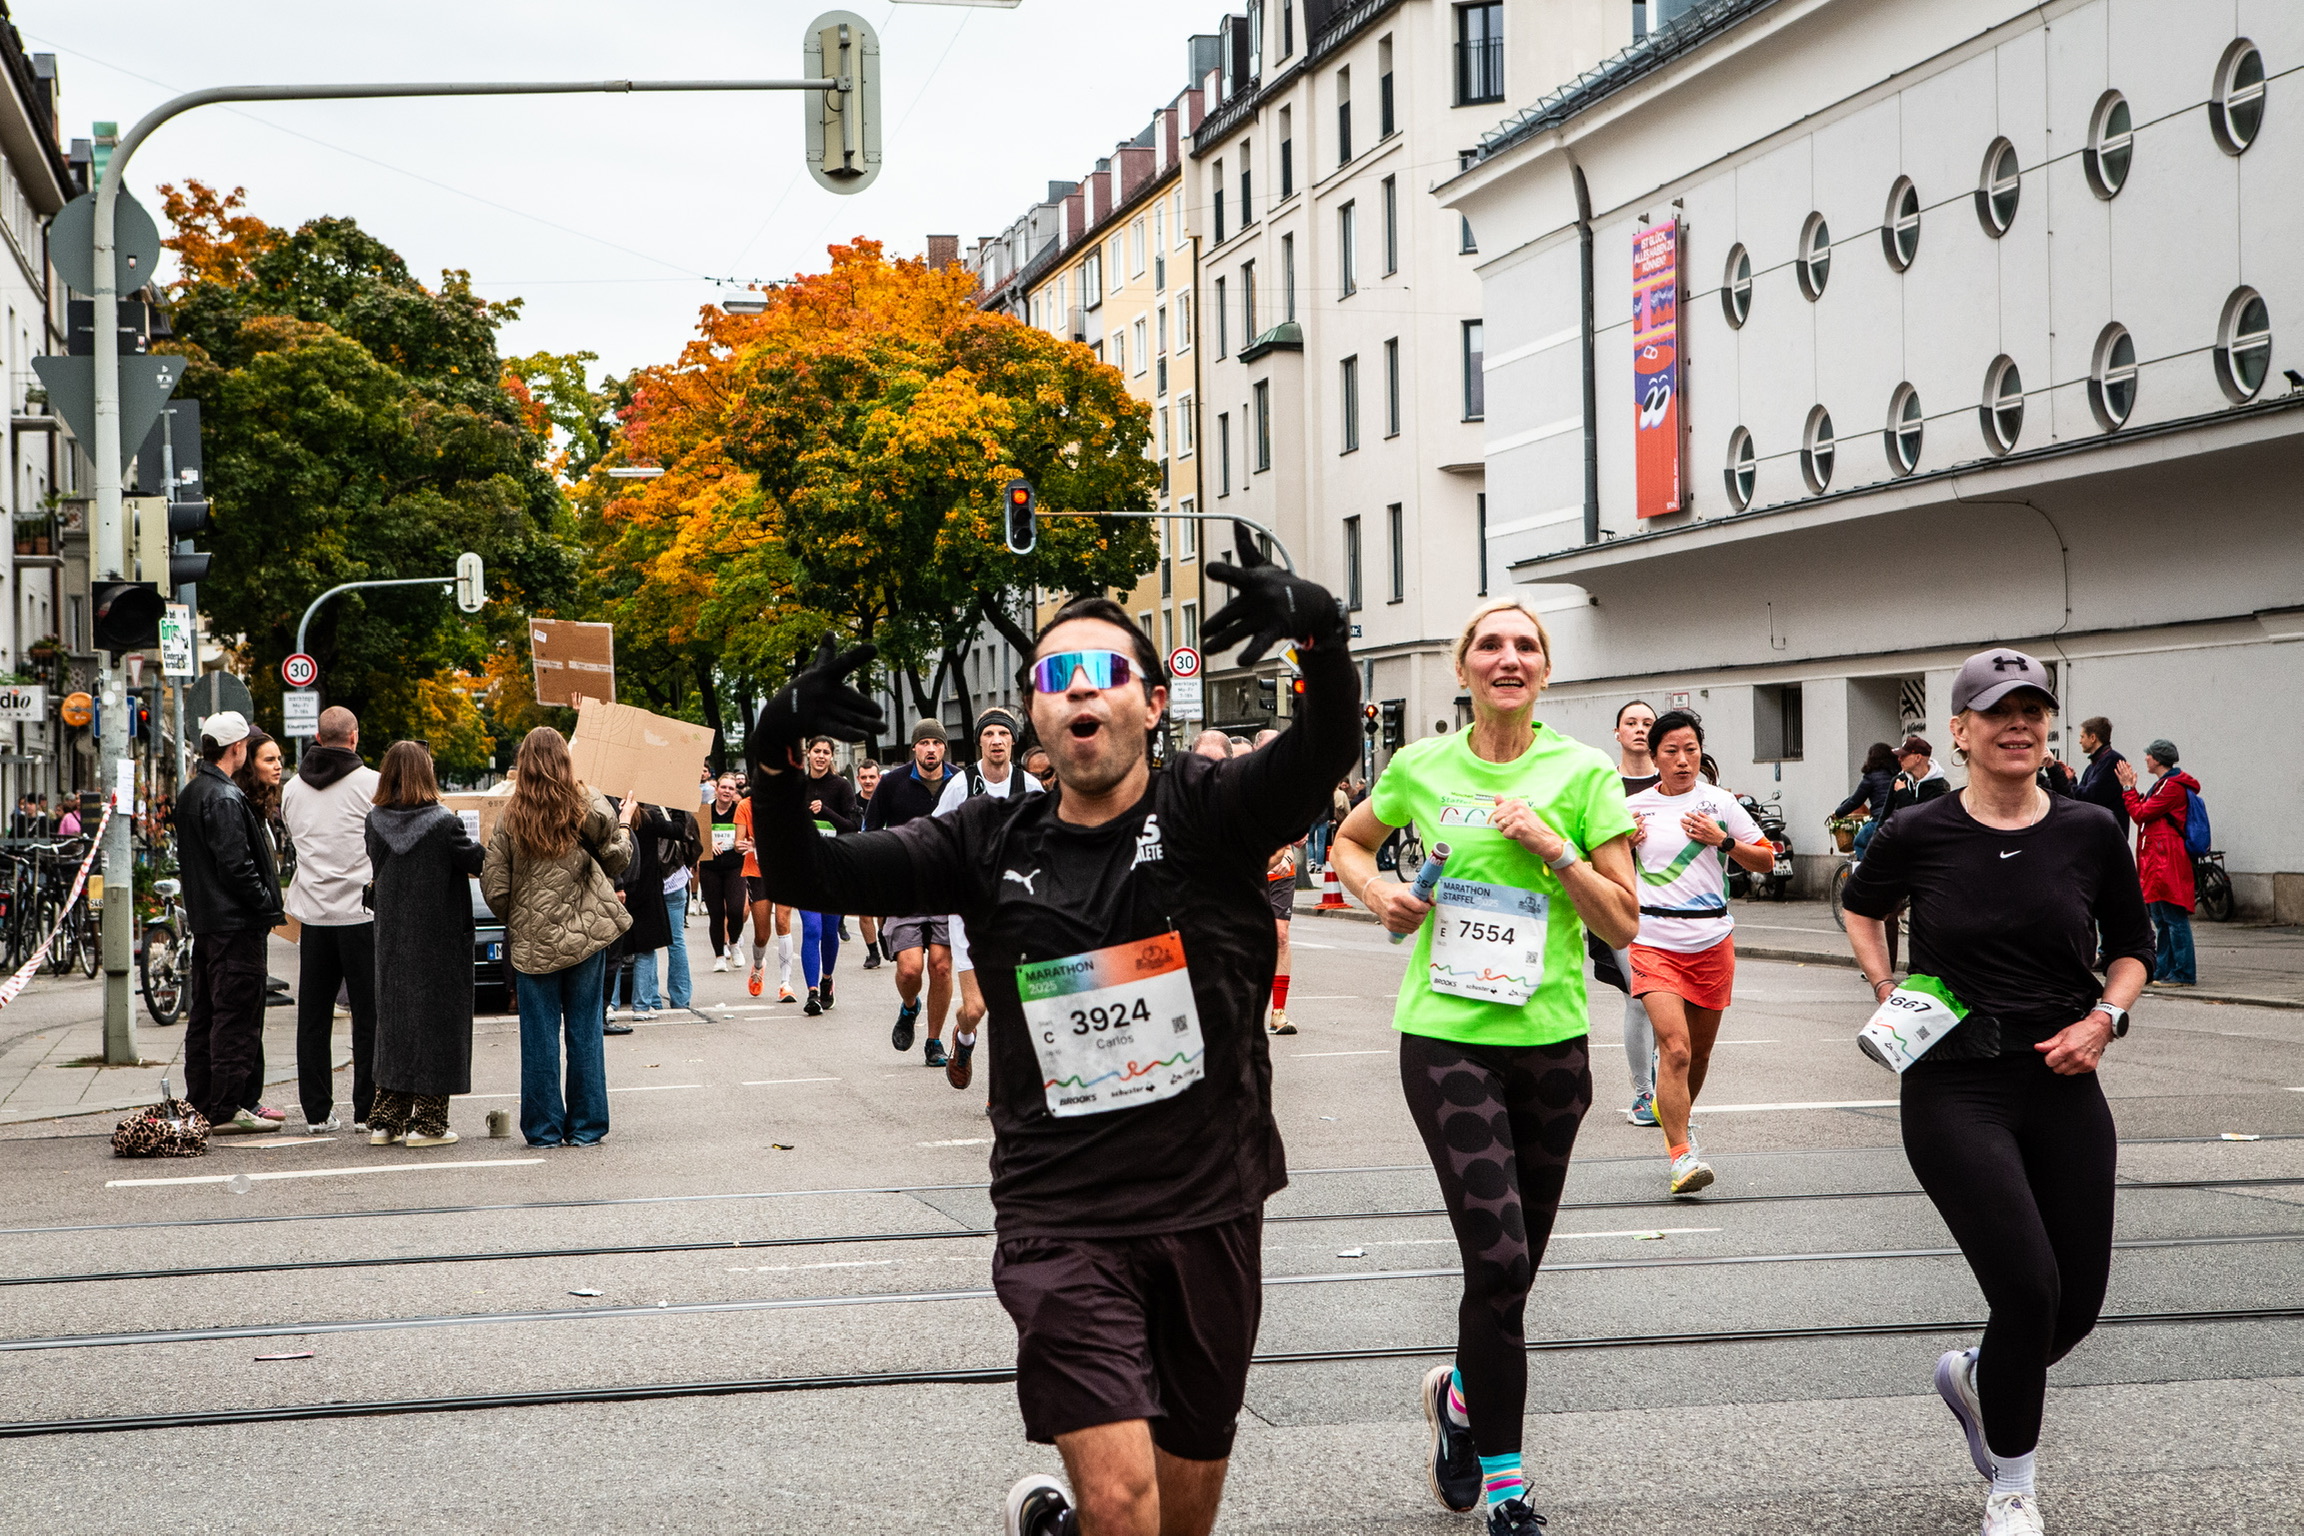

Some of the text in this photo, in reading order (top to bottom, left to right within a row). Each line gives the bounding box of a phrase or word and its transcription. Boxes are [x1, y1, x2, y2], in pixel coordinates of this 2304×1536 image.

[1176, 656, 1194, 669] 30
[290, 663, 309, 677] 30
[1443, 882, 1491, 897] MARATHON
[1442, 892, 1475, 904] STAFFEL
[1440, 920, 1515, 945] E 7554
[1025, 960, 1094, 982] MARATHON
[1028, 980, 1058, 995] 2025
[1433, 977, 1457, 988] BROOKS
[1888, 993, 1932, 1013] 667
[1070, 998, 1151, 1035] 3924
[1044, 1031, 1055, 1043] C
[1096, 1035, 1135, 1049] Carlos
[1060, 1093, 1097, 1106] BROOKS
